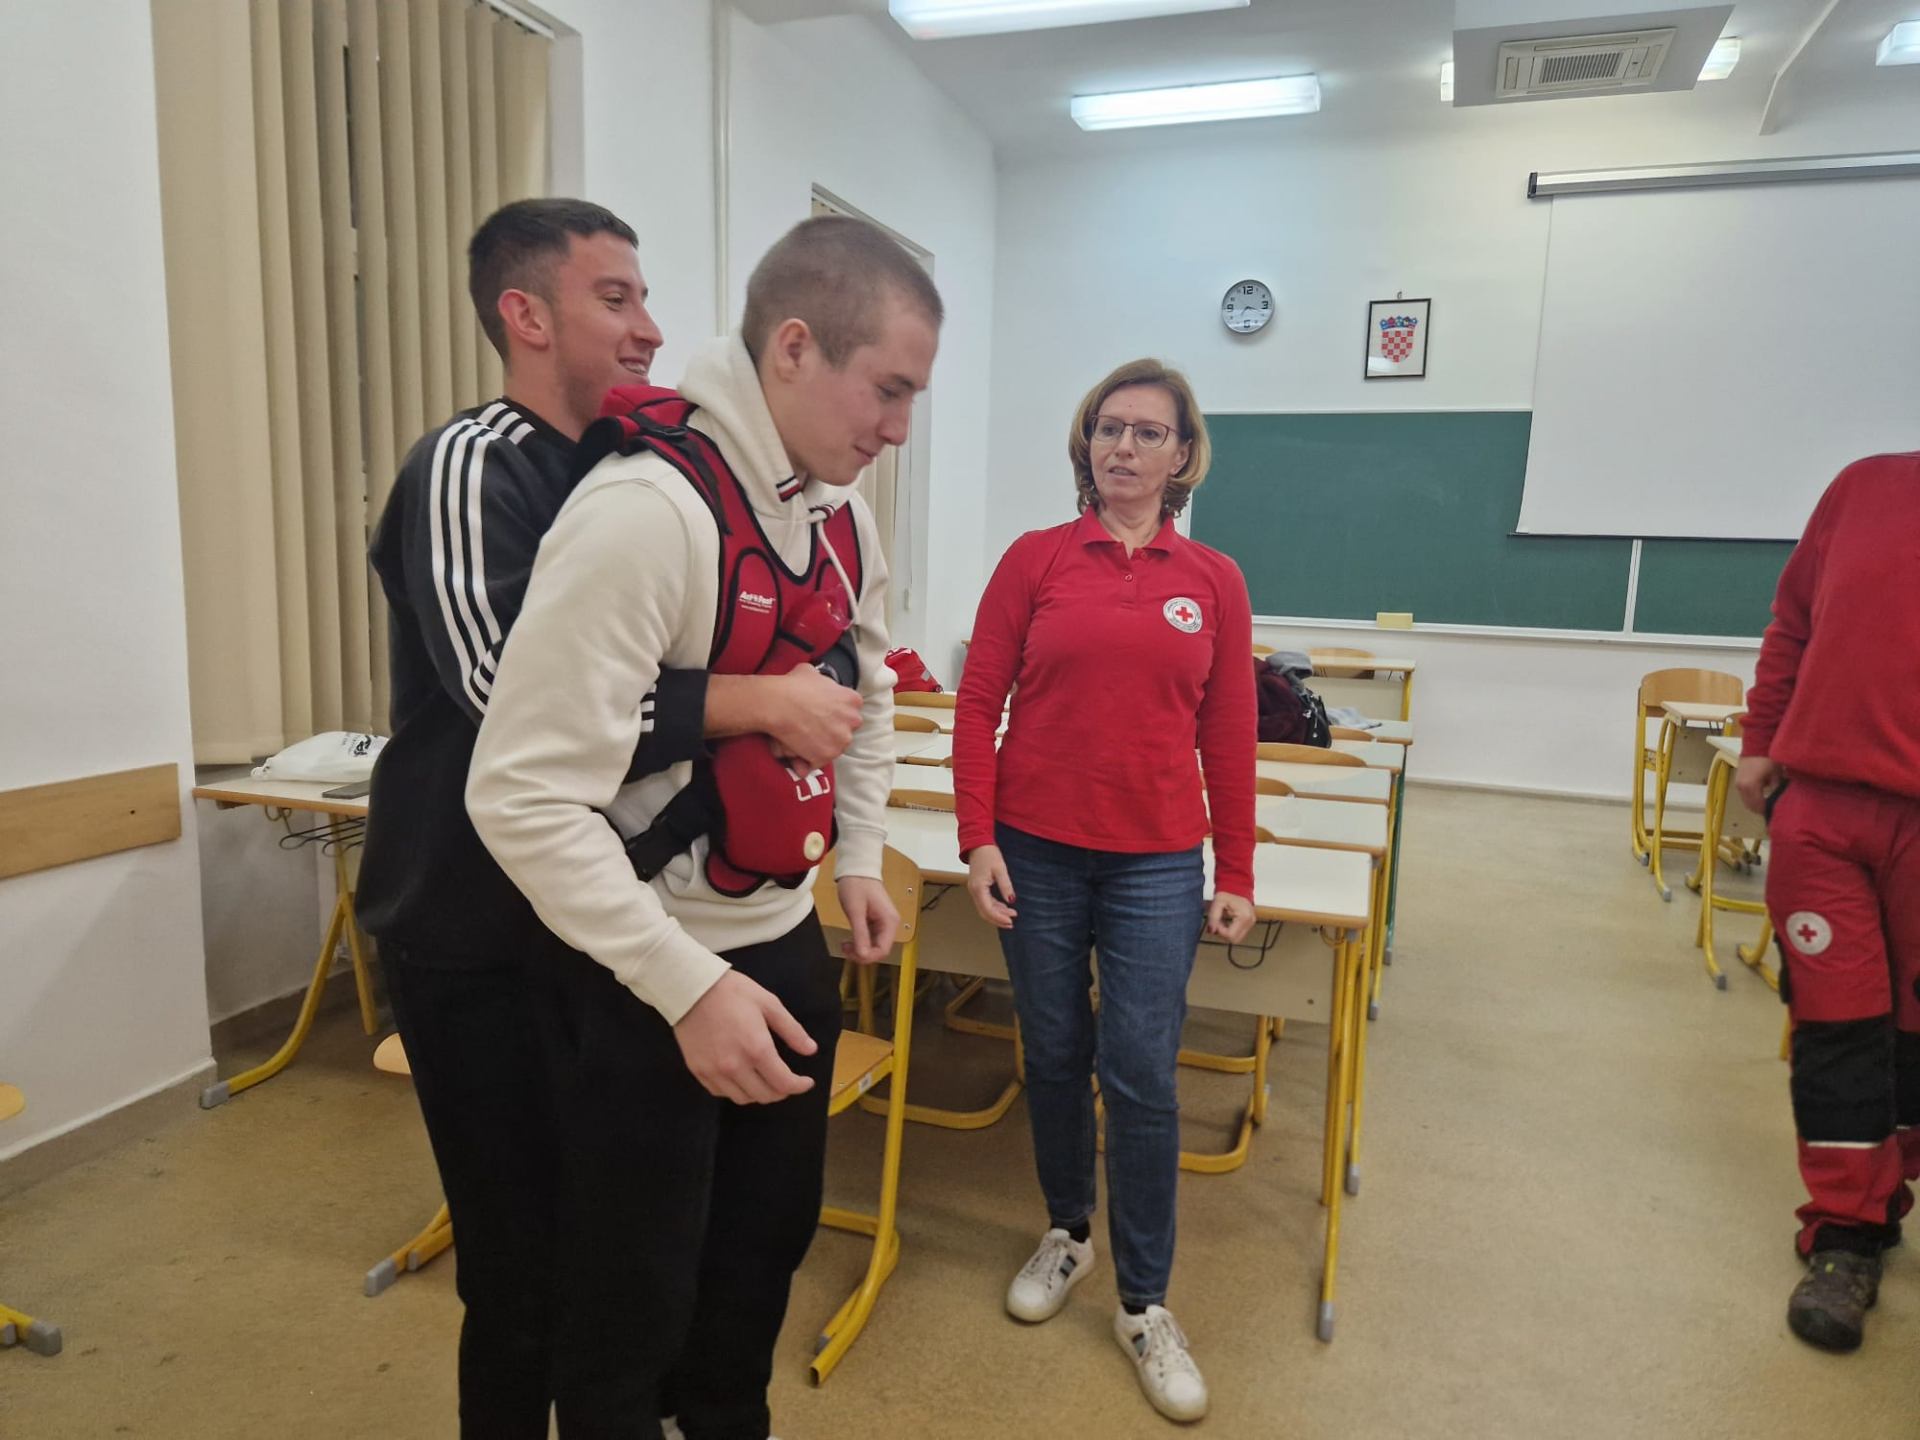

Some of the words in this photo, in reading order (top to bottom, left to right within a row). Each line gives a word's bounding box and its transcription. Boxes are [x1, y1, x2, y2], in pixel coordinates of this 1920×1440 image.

[1242, 285, 1253, 295] 12
[1226, 303, 1234, 313] 9
[1261, 300, 1269, 310] 3
